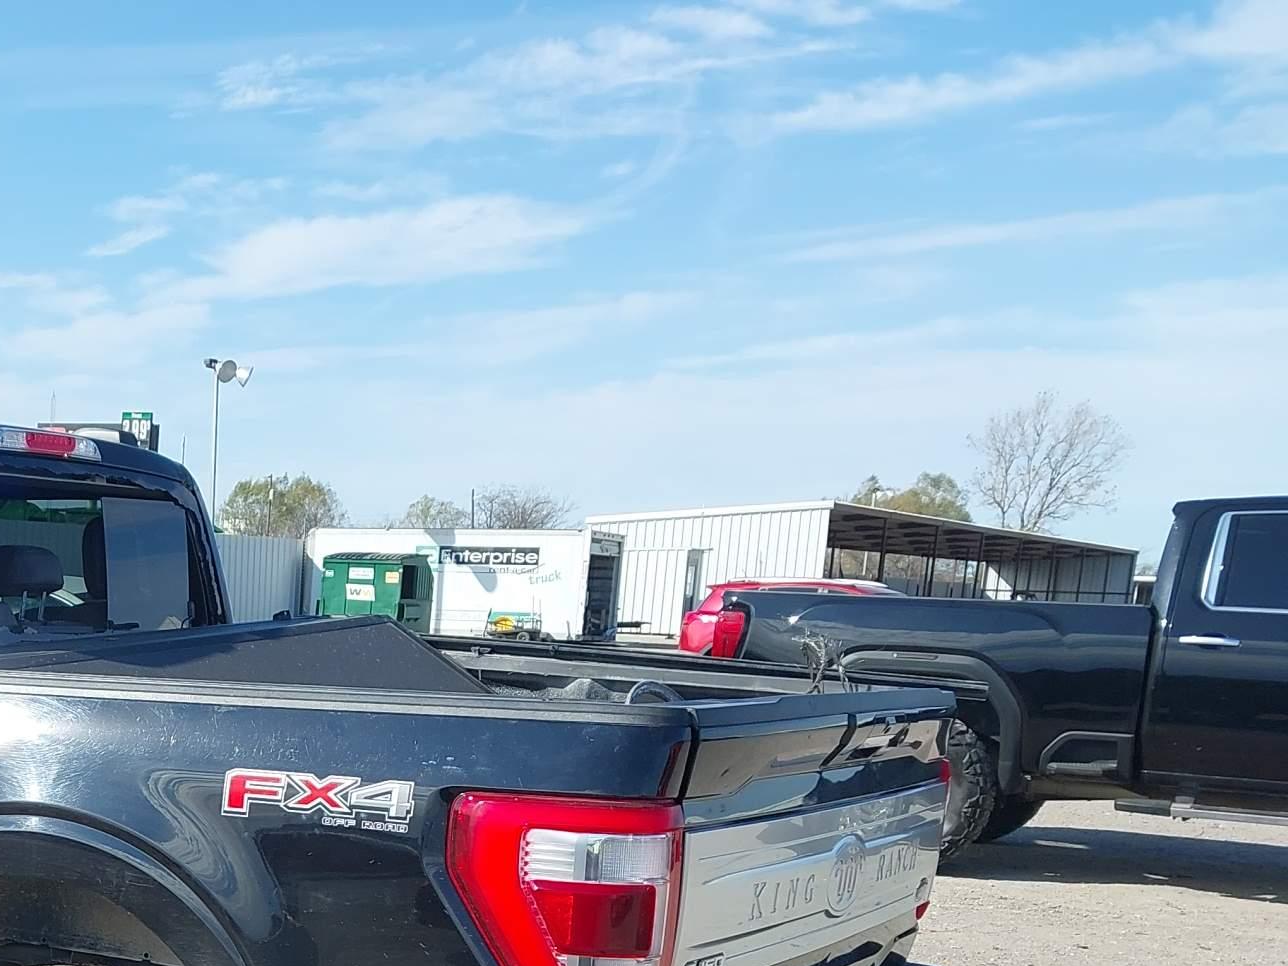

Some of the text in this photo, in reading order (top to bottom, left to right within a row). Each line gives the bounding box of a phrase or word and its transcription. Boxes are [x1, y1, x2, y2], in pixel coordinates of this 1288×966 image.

[440, 549, 538, 566] Enterprise
[529, 570, 561, 585] truck
[221, 768, 415, 823] FX4
[321, 816, 409, 833] OFF ROAD
[748, 847, 919, 921] KING RANCH
